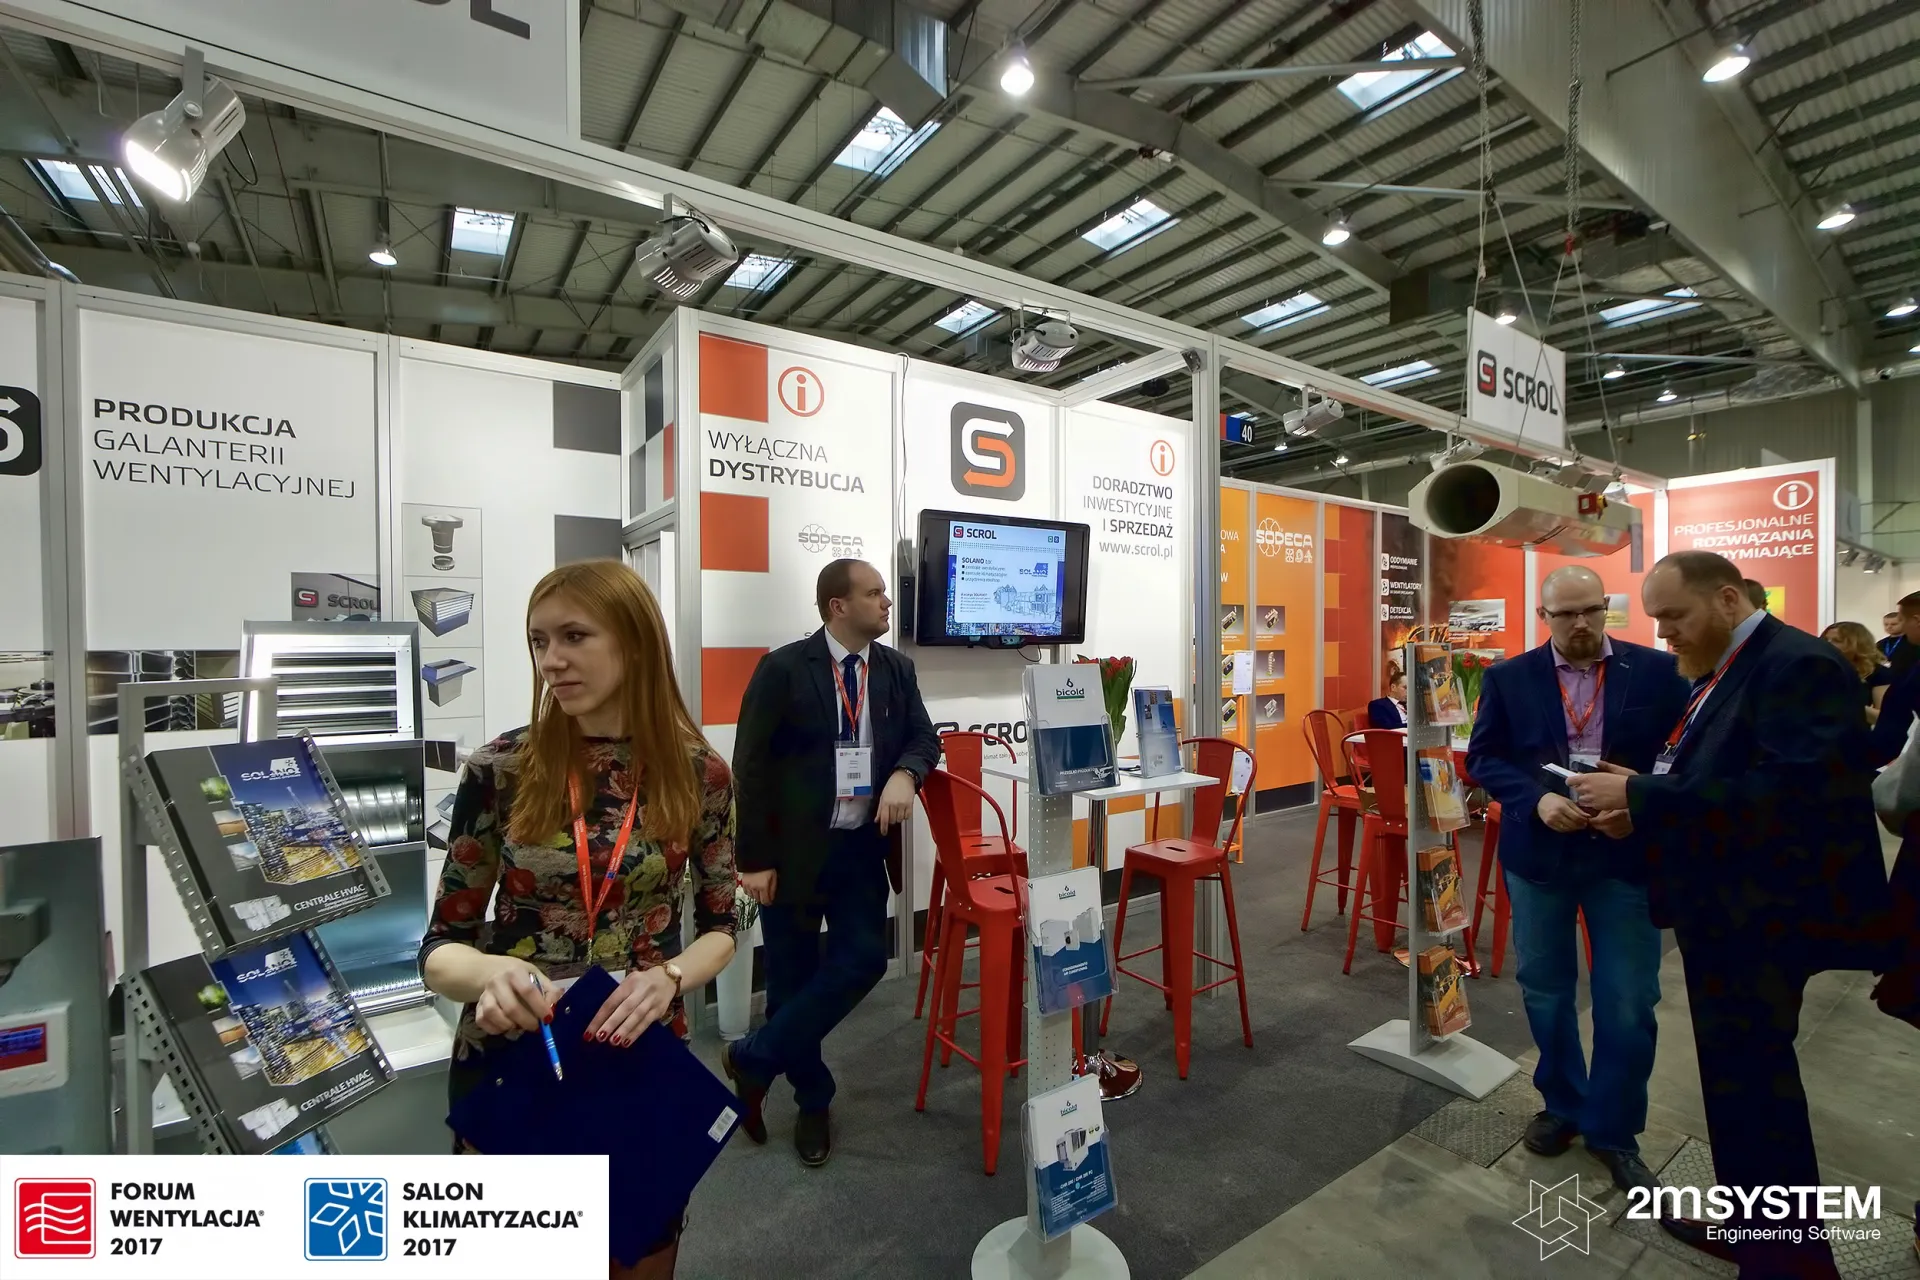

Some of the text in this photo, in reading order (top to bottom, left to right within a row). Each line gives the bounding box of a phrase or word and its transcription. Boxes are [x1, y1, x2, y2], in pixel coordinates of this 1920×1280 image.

[1503, 366, 1558, 416] SCROL
[94, 398, 297, 439] PRODUKCJA
[1241, 424, 1253, 443] 40
[93, 429, 285, 466] GALANTERII
[707, 429, 828, 464] WYŁĄCZNA
[92, 459, 356, 499] WENTYLACYJNEJ
[709, 458, 865, 494] DYSTRYBUCJA
[1092, 475, 1173, 500] DORADZTWO
[1083, 495, 1173, 520] INWESTYCYJNE
[966, 528, 998, 540] SCROL
[1102, 518, 1174, 539] I SPRZEDAŻ
[1674, 512, 1815, 537] PROFESJONALNE
[798, 531, 864, 548] SODECA
[1098, 541, 1173, 561] www.scrol.pl
[1255, 529, 1314, 549] SODECA
[1692, 528, 1815, 549] ROZWIĄZANIA
[327, 593, 378, 611] SCROL
[1055, 688, 1085, 696] bicold
[240, 767, 301, 782] SOLANO
[293, 890, 342, 912] CENTRALE
[339, 883, 366, 899] HVAC
[236, 958, 297, 984] SOLANO
[300, 1081, 347, 1112] CENTRALE
[346, 1069, 372, 1092] HVAC
